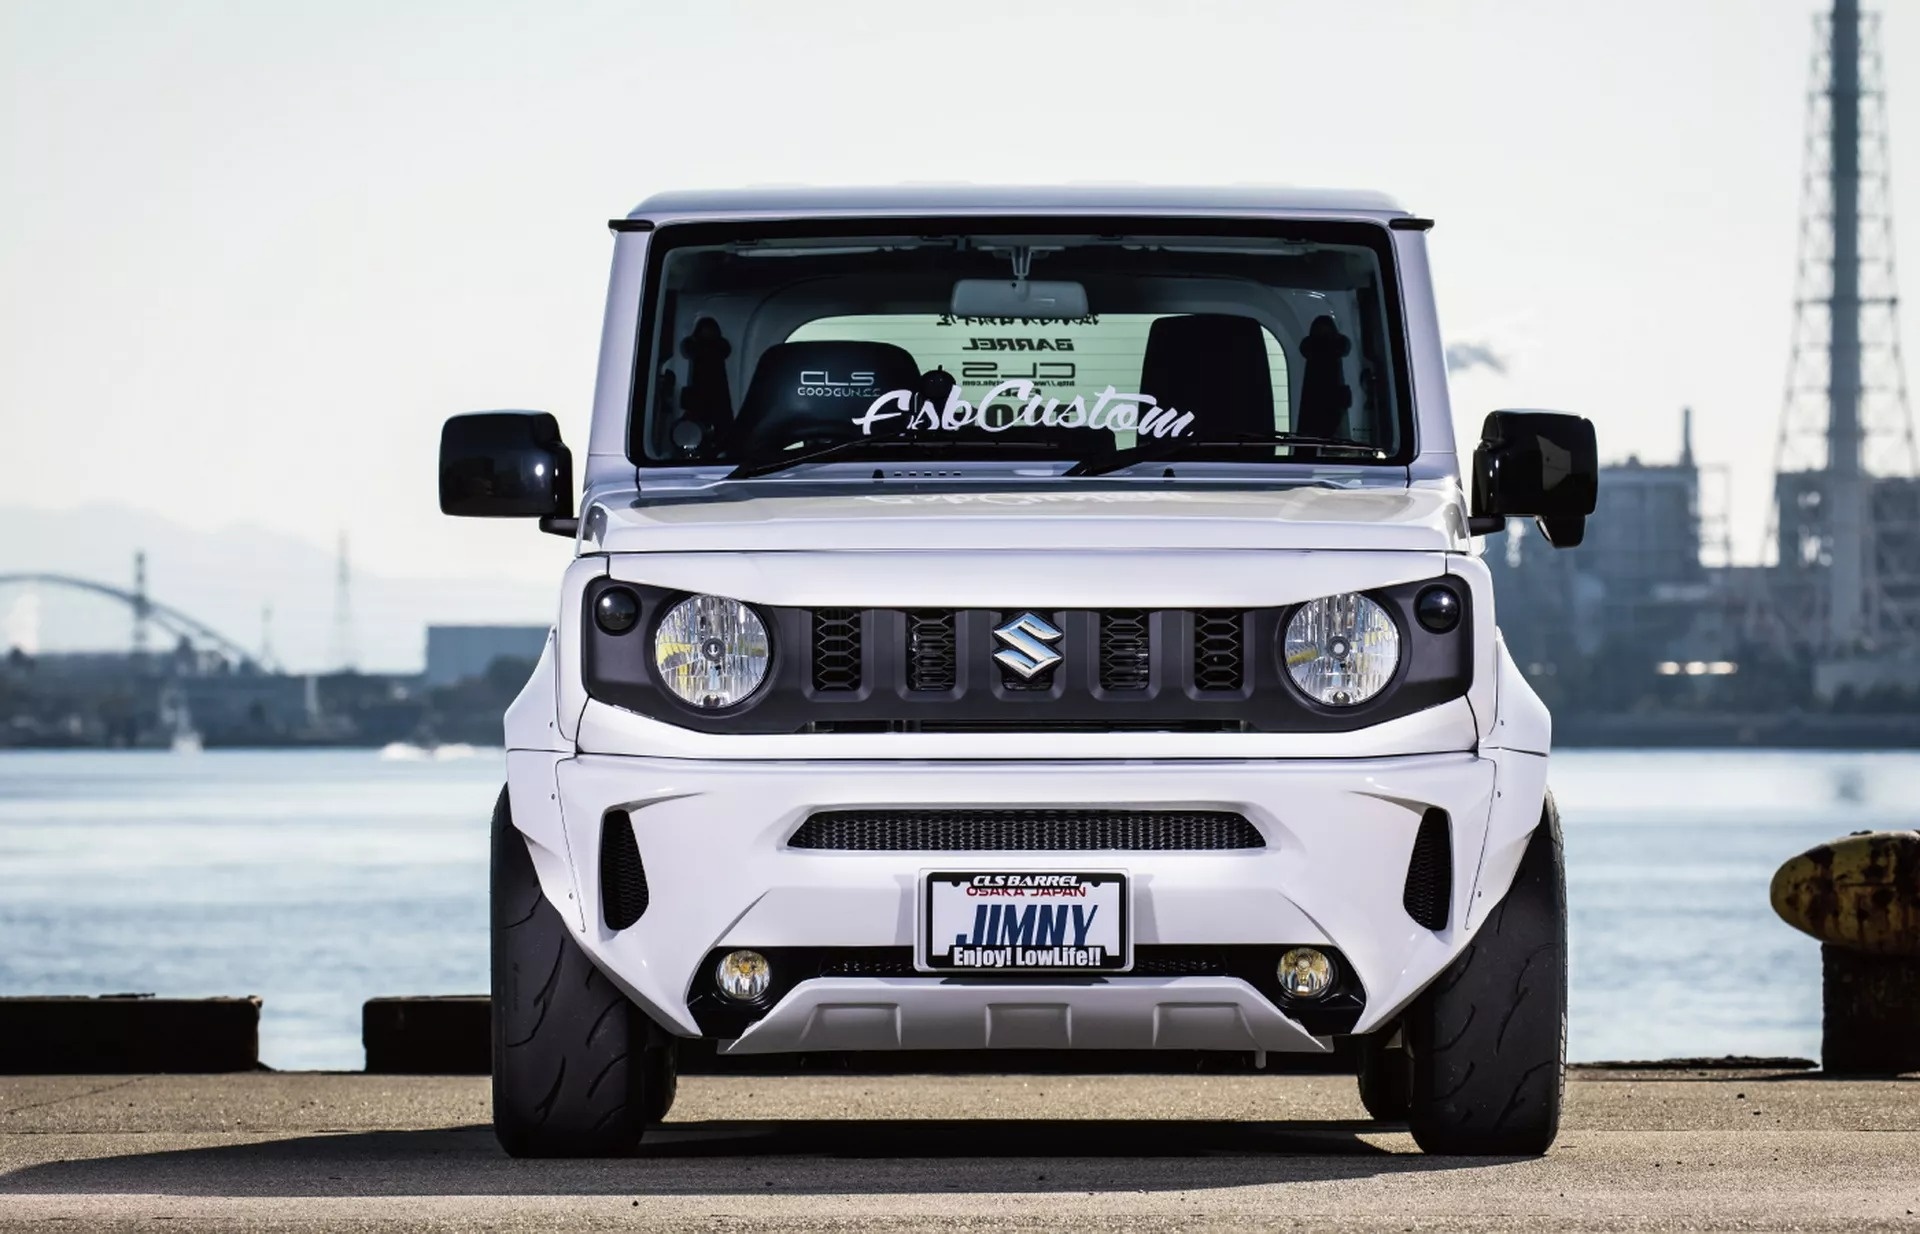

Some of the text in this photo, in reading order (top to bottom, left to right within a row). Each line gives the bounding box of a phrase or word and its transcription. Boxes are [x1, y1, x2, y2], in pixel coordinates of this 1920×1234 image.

[800, 371, 876, 386] CLS
[973, 875, 1080, 887] CLS BARREL
[966, 887, 1087, 897] OSAKA JAPAN
[955, 904, 1098, 946] JIMNY
[953, 946, 1101, 967] Enjoy! LowLife!!
